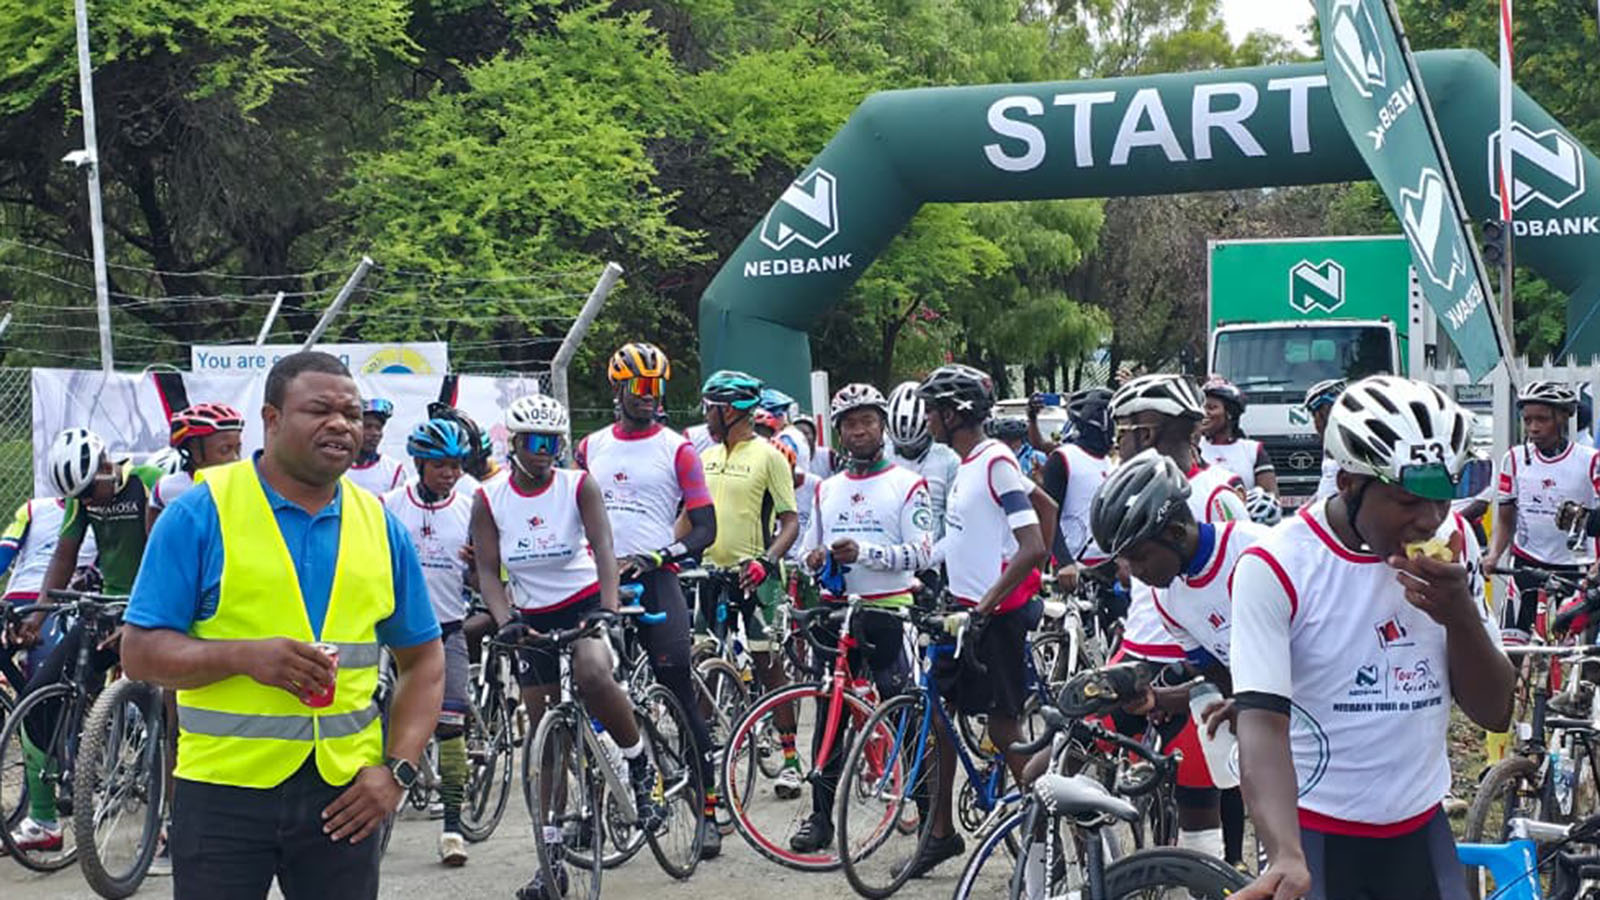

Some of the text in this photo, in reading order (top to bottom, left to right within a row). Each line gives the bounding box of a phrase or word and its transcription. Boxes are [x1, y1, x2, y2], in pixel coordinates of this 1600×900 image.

[984, 75, 1328, 172] START
[1513, 217, 1600, 236] DBANK
[743, 253, 852, 278] NEDBANK
[197, 352, 231, 368] You
[237, 355, 266, 368] are
[1410, 442, 1446, 463] 53
